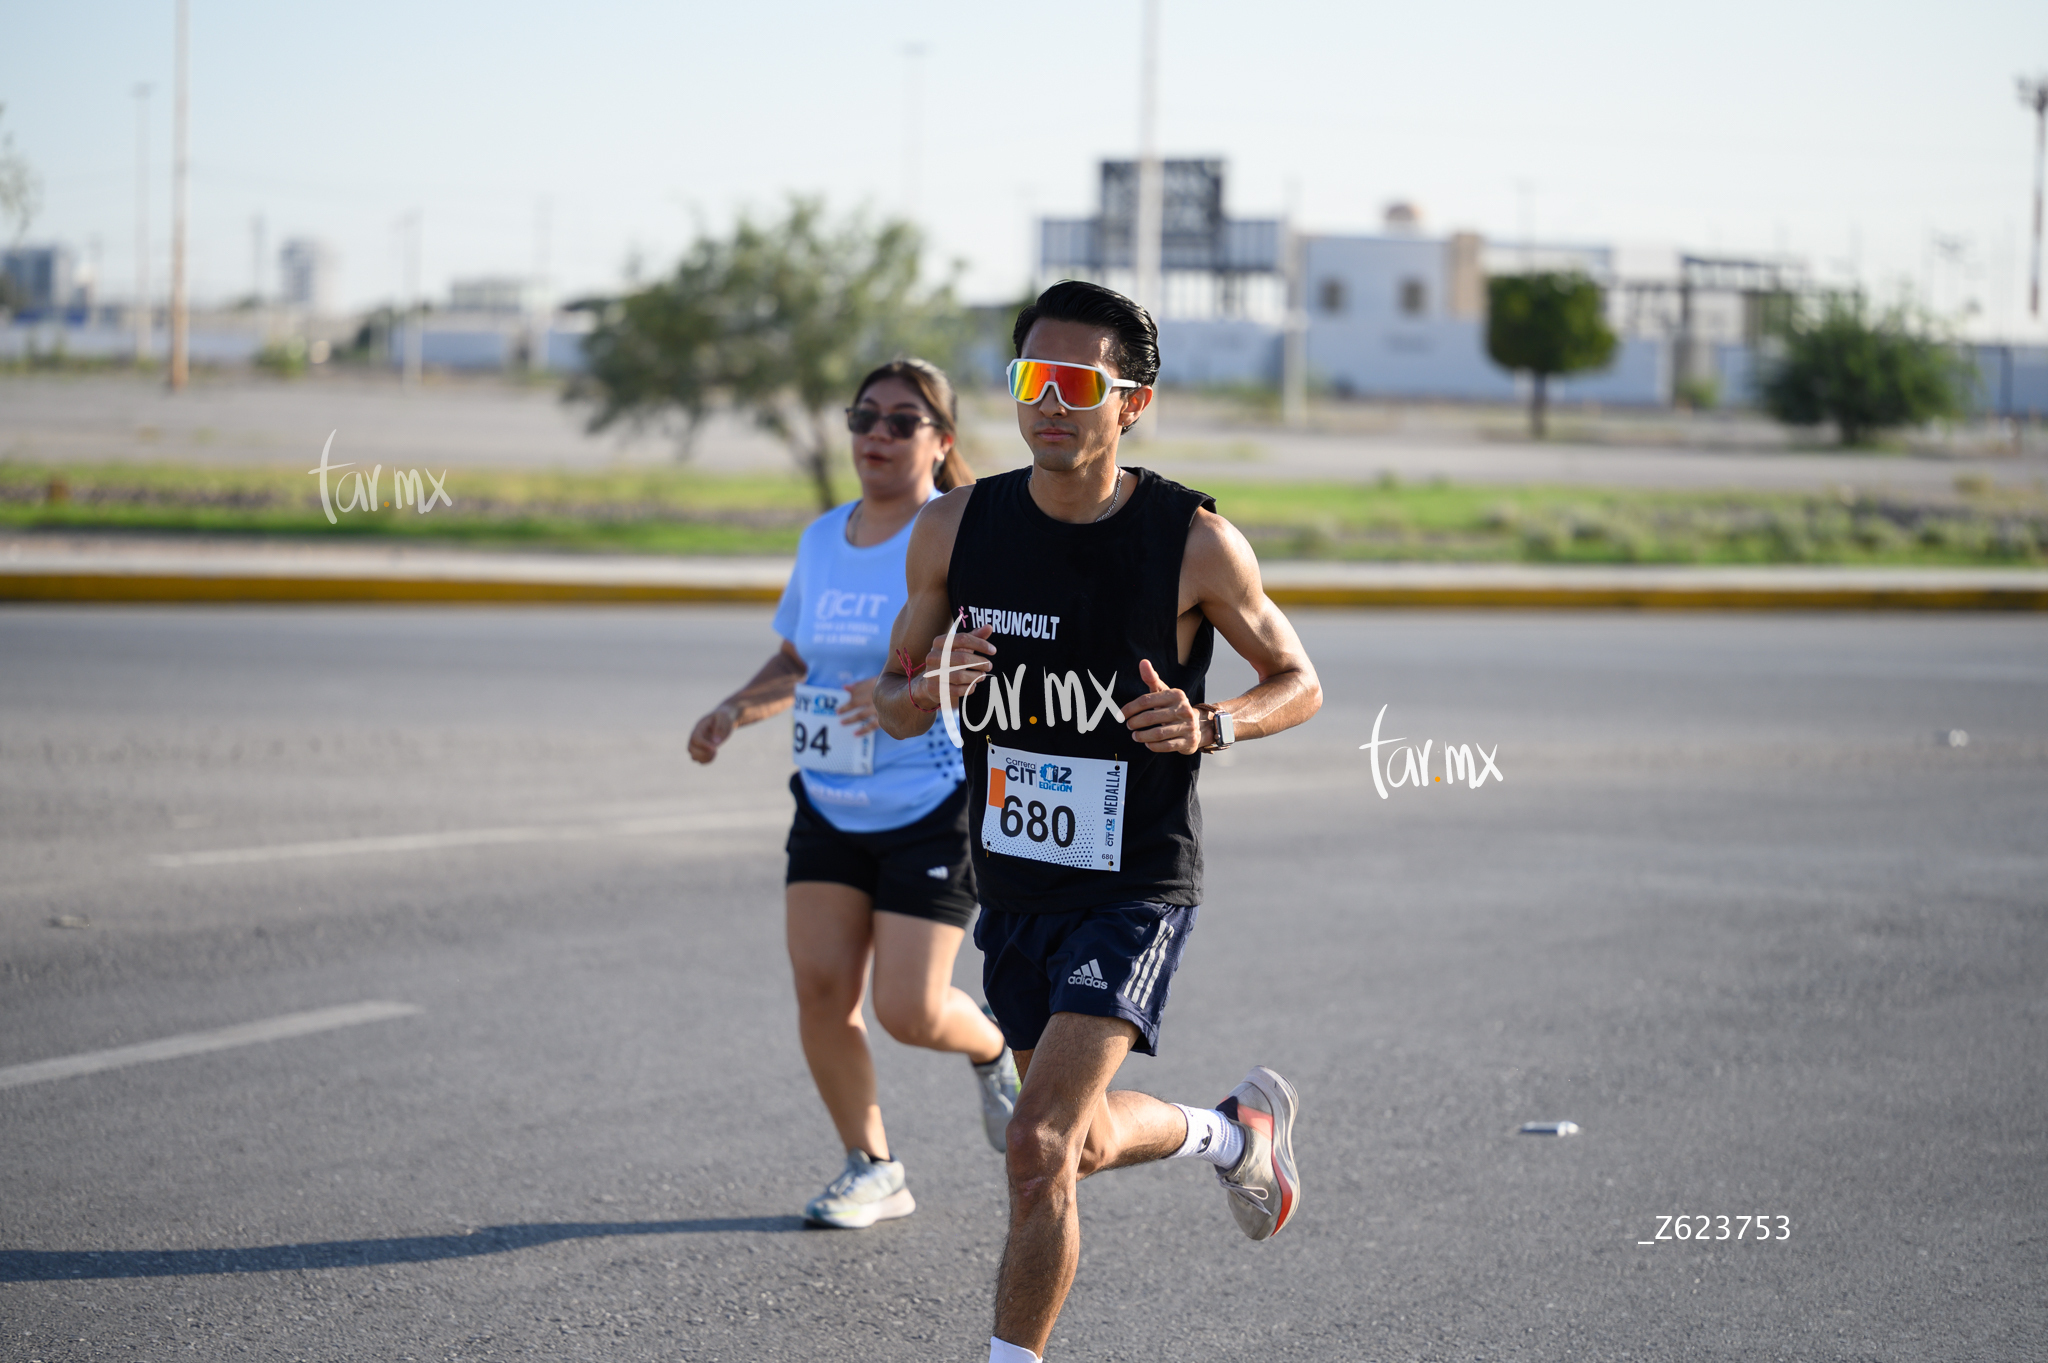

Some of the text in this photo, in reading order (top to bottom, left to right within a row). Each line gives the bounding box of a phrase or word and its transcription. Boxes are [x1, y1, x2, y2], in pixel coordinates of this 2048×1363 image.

[968, 605, 1060, 640] THERUNCULT
[794, 722, 831, 757] 94
[1005, 757, 1036, 769] Carrera
[1005, 764, 1037, 786] CIT
[1103, 771, 1121, 815] MEDALLA
[1000, 795, 1076, 848] 680
[1067, 975, 1109, 990] adidas
